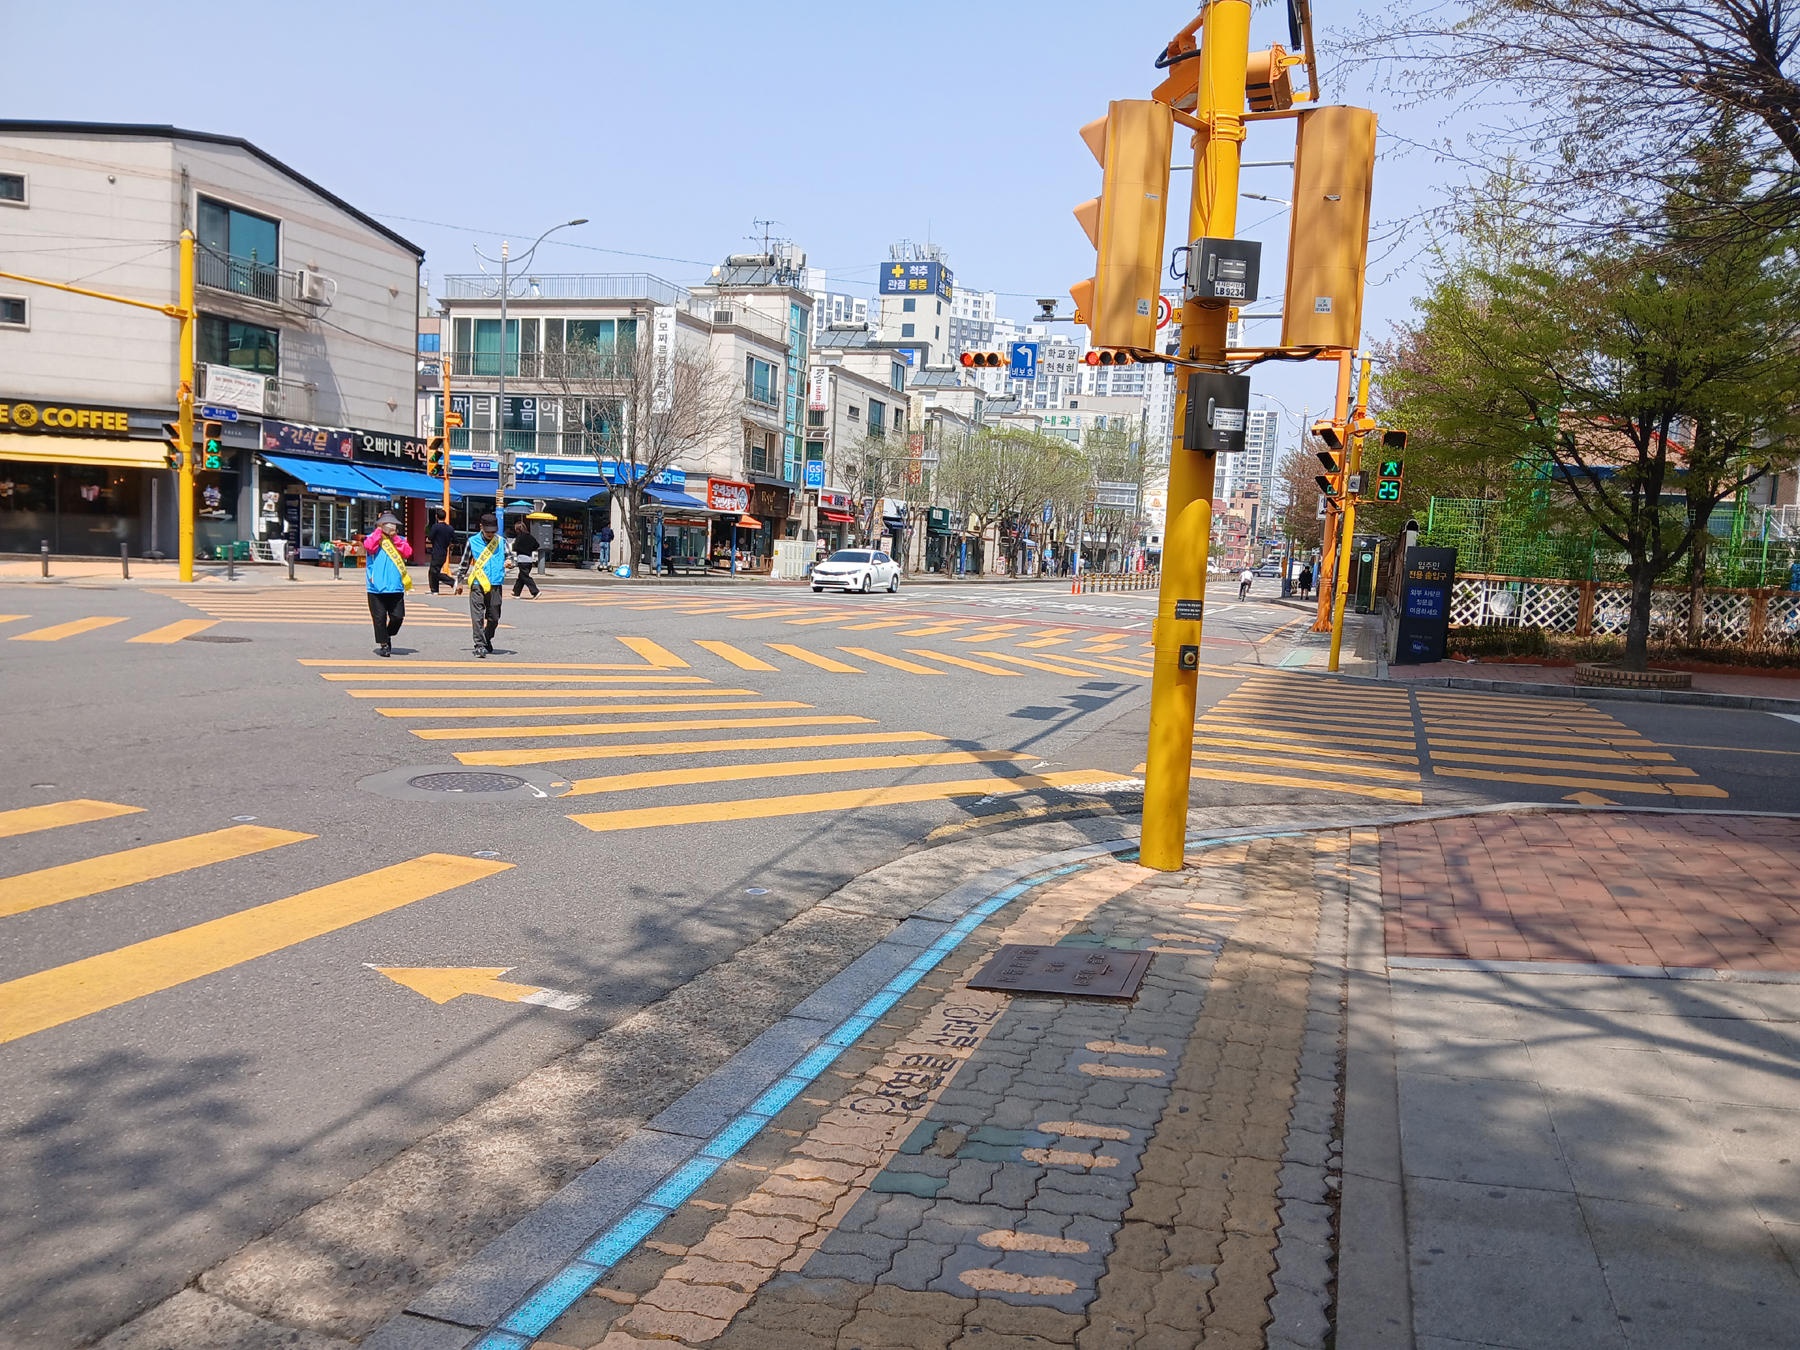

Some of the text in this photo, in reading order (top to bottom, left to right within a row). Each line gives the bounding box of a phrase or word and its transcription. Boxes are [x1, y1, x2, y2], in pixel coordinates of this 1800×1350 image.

[909, 265, 928, 277] 척추
[888, 279, 907, 291] 관절
[1011, 367, 1034, 377] 비보호
[1046, 362, 1074, 374] 천천히
[42, 407, 128, 431] COFFEE
[362, 435, 401, 457] 오빠네
[206, 456, 220, 468] 25
[809, 464, 821, 473] GS
[809, 473, 820, 482] 25
[1379, 481, 1398, 499] 25
[1417, 561, 1440, 570] 입주민
[1409, 570, 1447, 580] 전용 출입구
